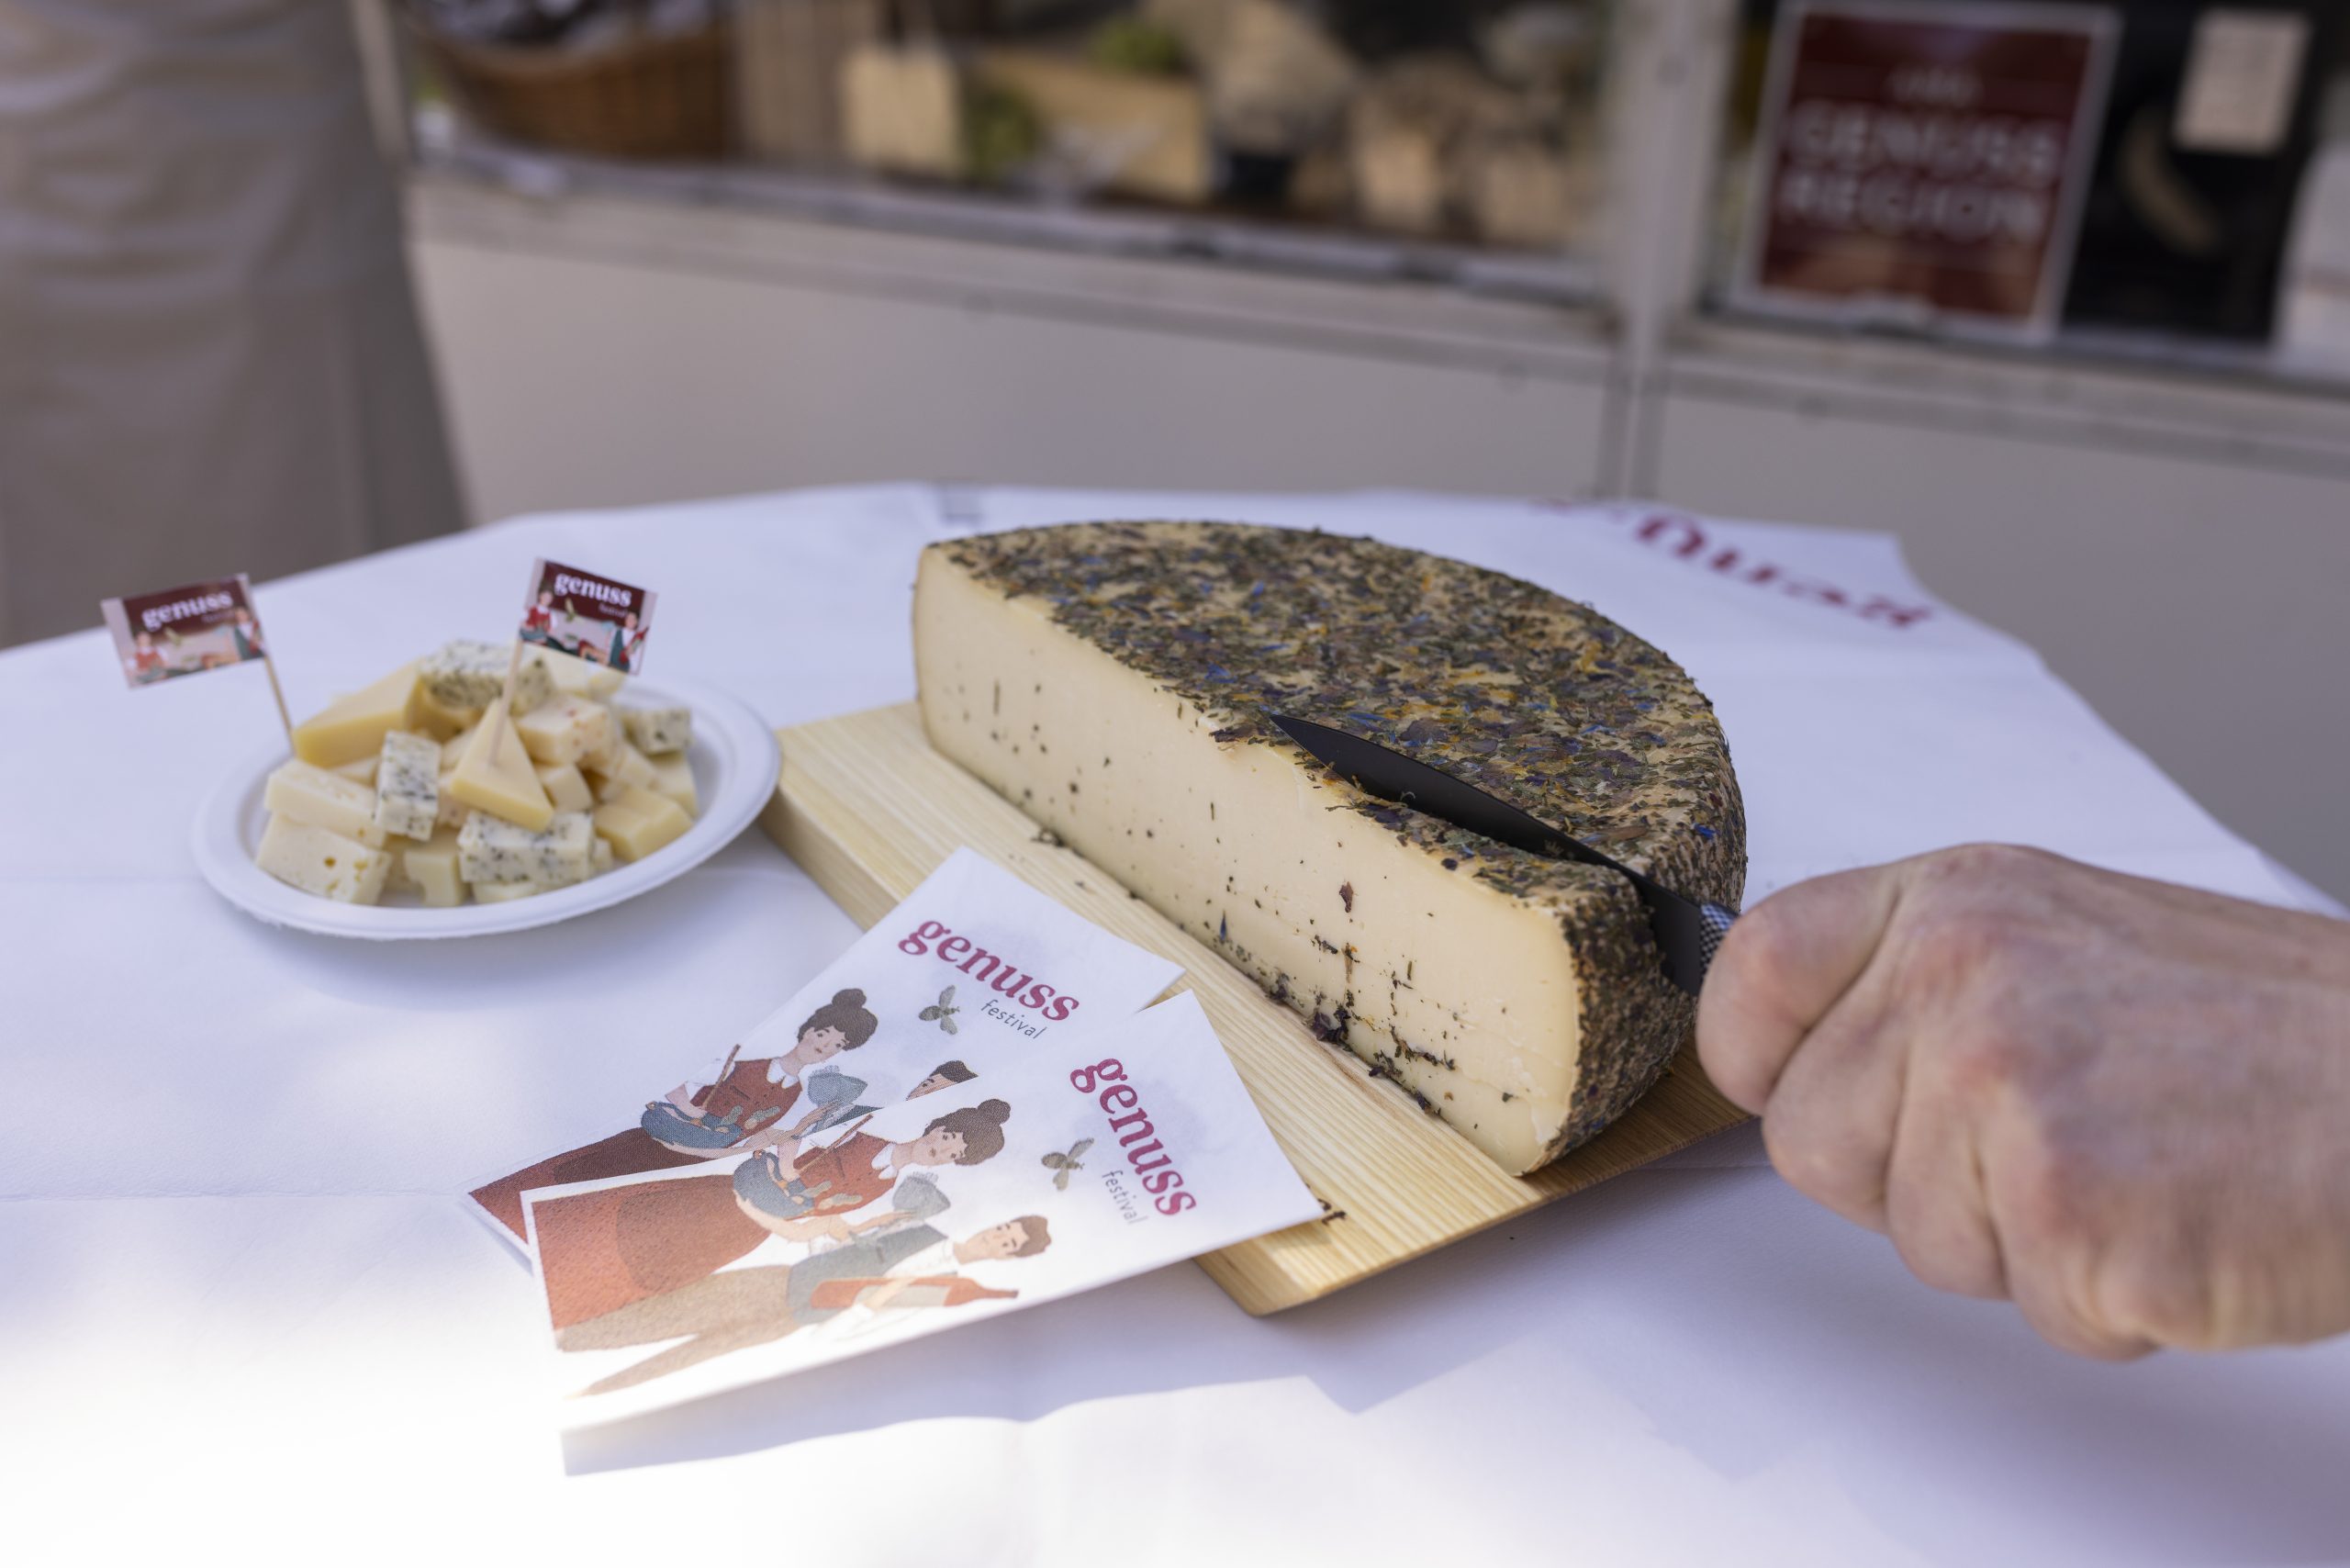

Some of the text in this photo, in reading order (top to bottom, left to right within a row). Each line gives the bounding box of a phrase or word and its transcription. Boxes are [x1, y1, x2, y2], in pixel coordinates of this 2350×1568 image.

[1786, 99, 2062, 180] GENUSS
[1777, 168, 2045, 241] REGION
[141, 590, 234, 633] genuss
[554, 573, 632, 608] genuss
[898, 920, 1080, 1021] genuss
[980, 999, 1047, 1039] festival
[1069, 1058, 1197, 1215] genuss
[1102, 1170, 1149, 1225] festival
